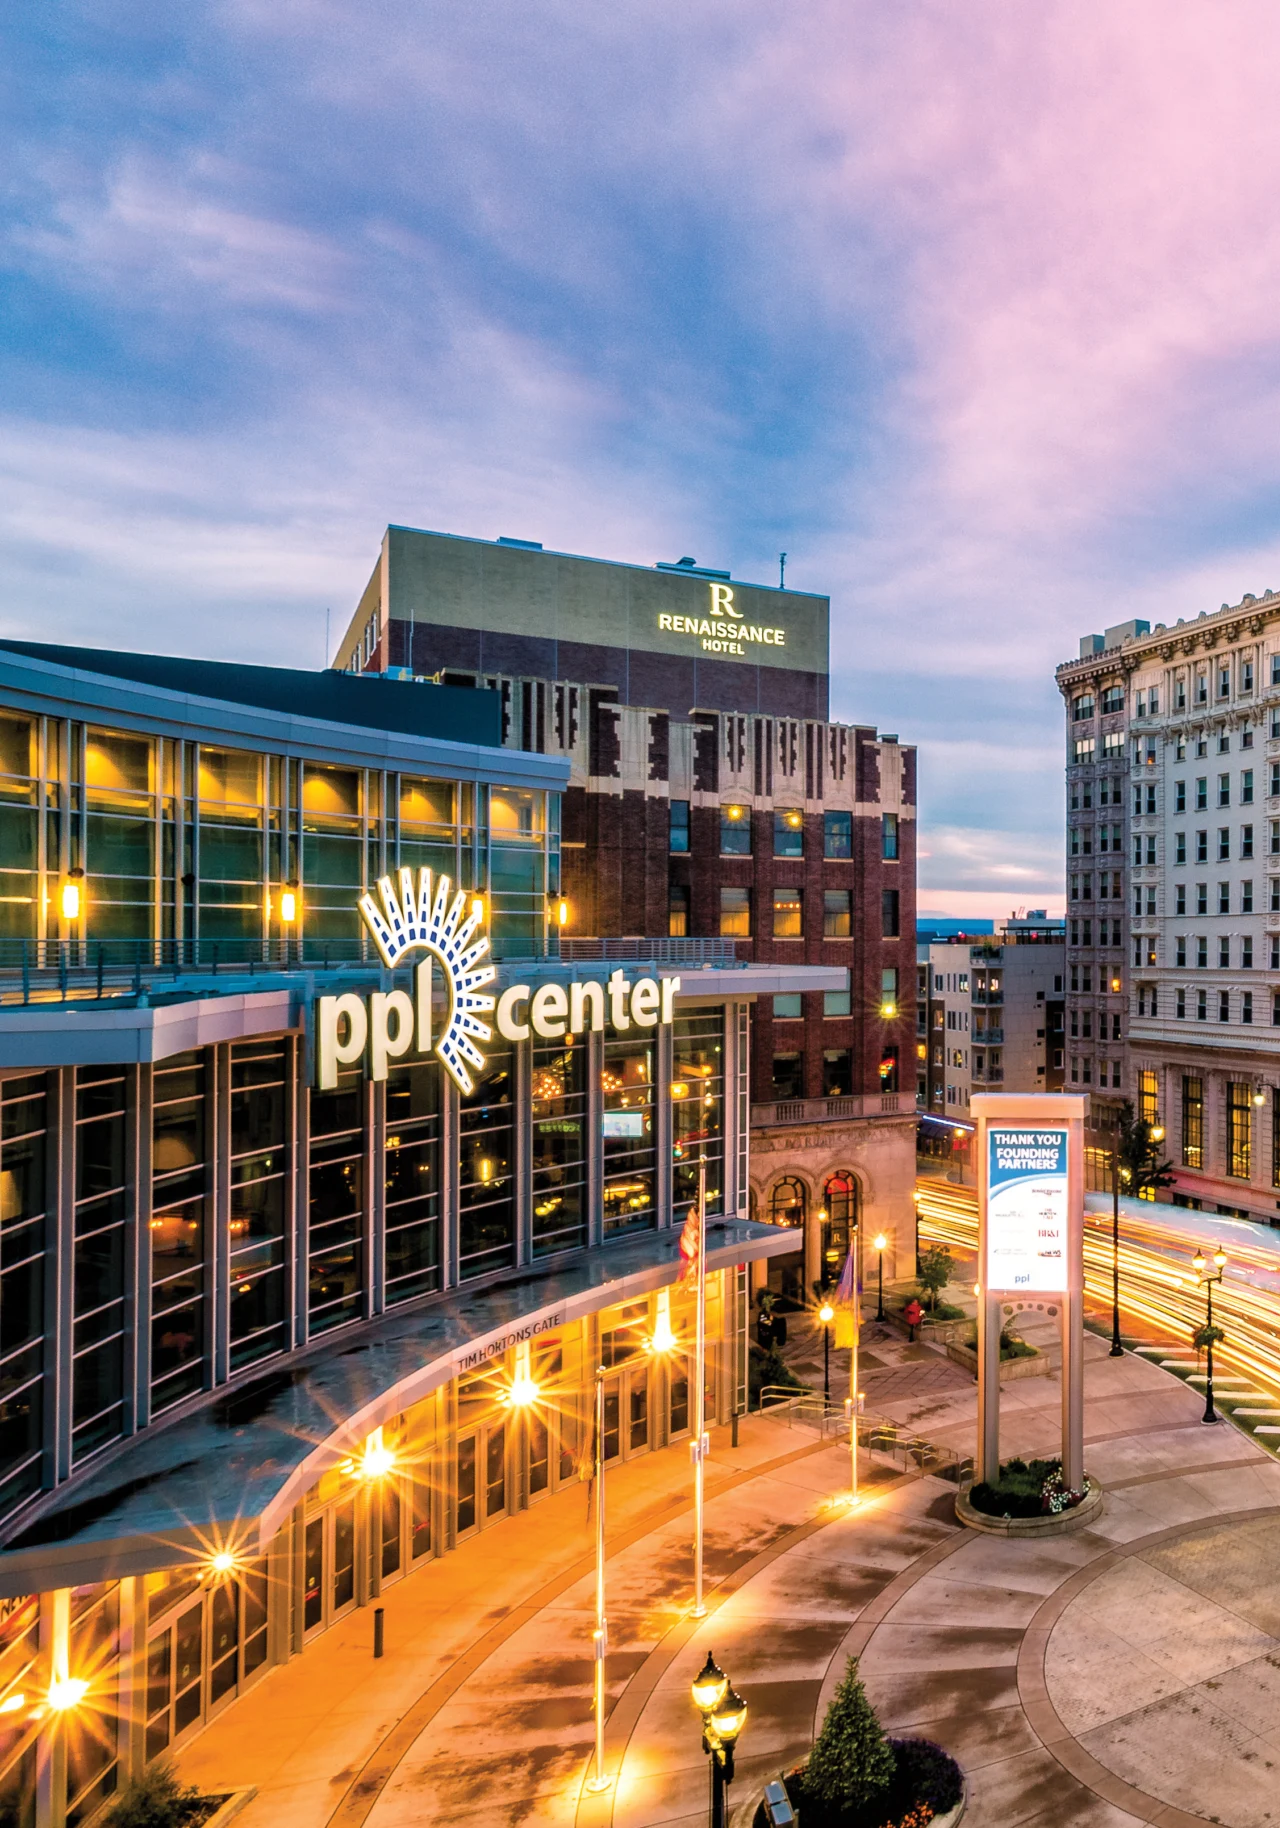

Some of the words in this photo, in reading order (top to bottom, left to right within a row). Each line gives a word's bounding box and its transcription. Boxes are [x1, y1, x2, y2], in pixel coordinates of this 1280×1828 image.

[708, 583, 744, 618] R
[659, 613, 785, 645] RENAISSANCE
[702, 638, 745, 655] HOTEL
[319, 954, 432, 1090] ppl
[497, 968, 680, 1041] center
[994, 1134, 1035, 1145] THANK
[1036, 1134, 1061, 1146] YOU
[996, 1148, 1059, 1159] FOUNDING
[998, 1158, 1058, 1170] PARTNERS
[1014, 1274, 1030, 1283] ppl
[458, 1353, 477, 1372] TIM
[479, 1327, 531, 1361] HORTONS
[533, 1314, 561, 1335] GATE
